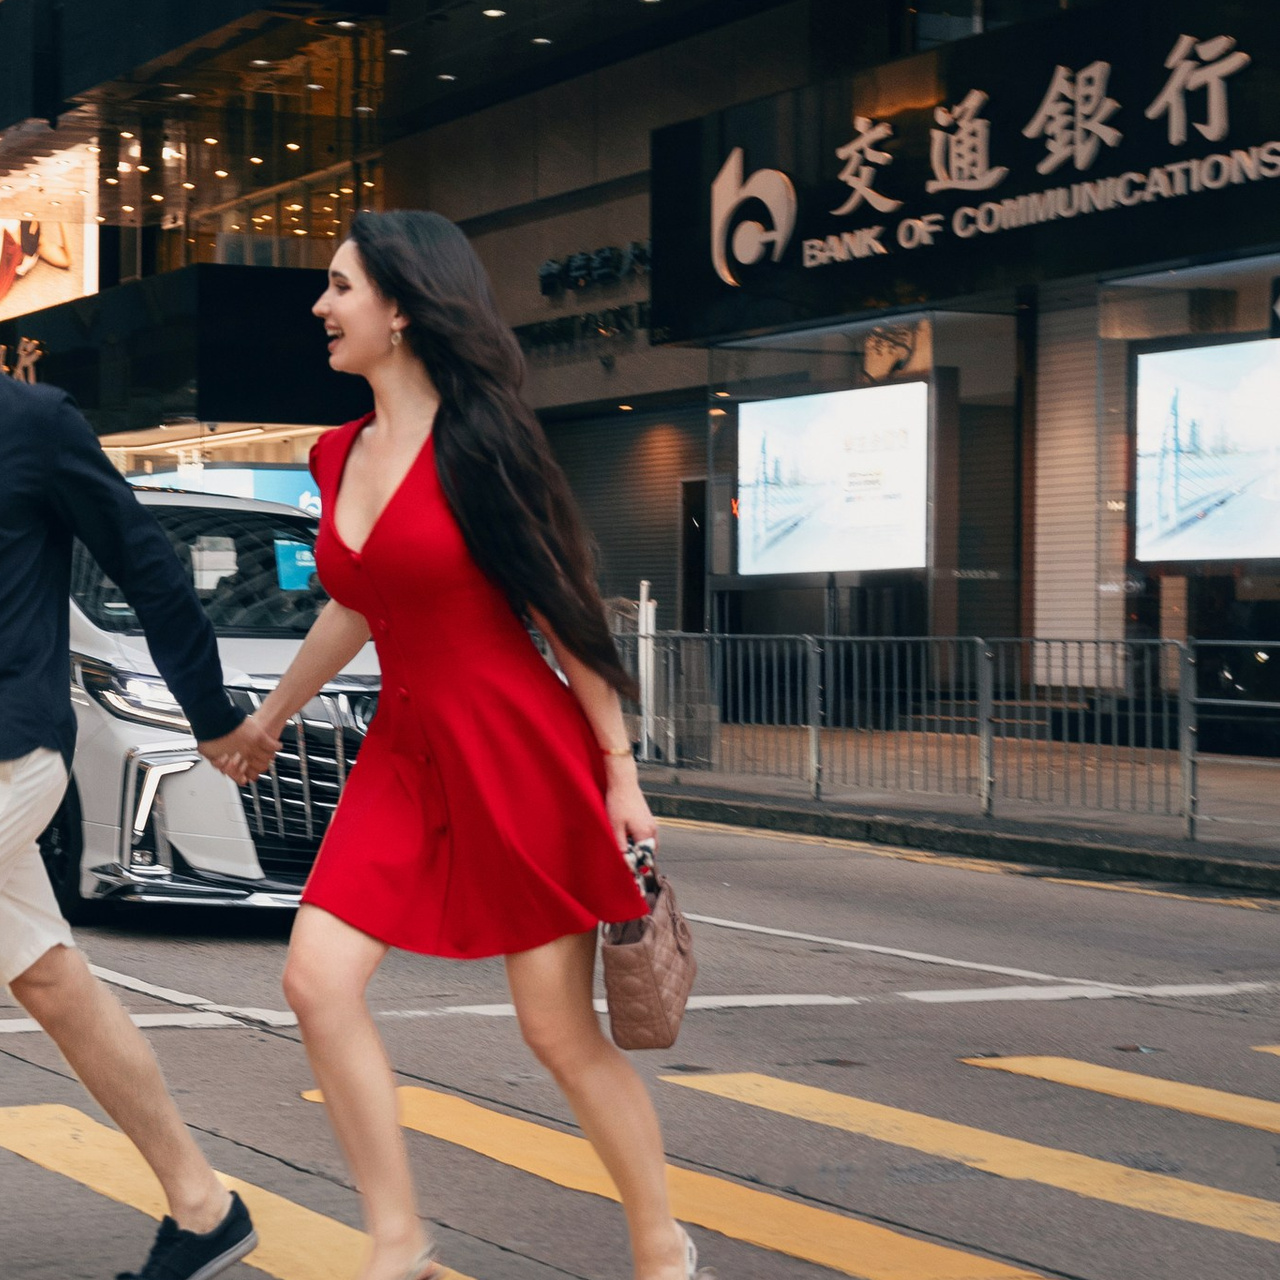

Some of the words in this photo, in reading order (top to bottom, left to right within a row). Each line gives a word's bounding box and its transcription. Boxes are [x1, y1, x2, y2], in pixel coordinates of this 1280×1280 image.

[829, 33, 1252, 216] 交通銀行
[802, 225, 888, 268] BANK
[896, 213, 945, 250] OF
[952, 140, 1280, 238] COMMUNICATIONS
